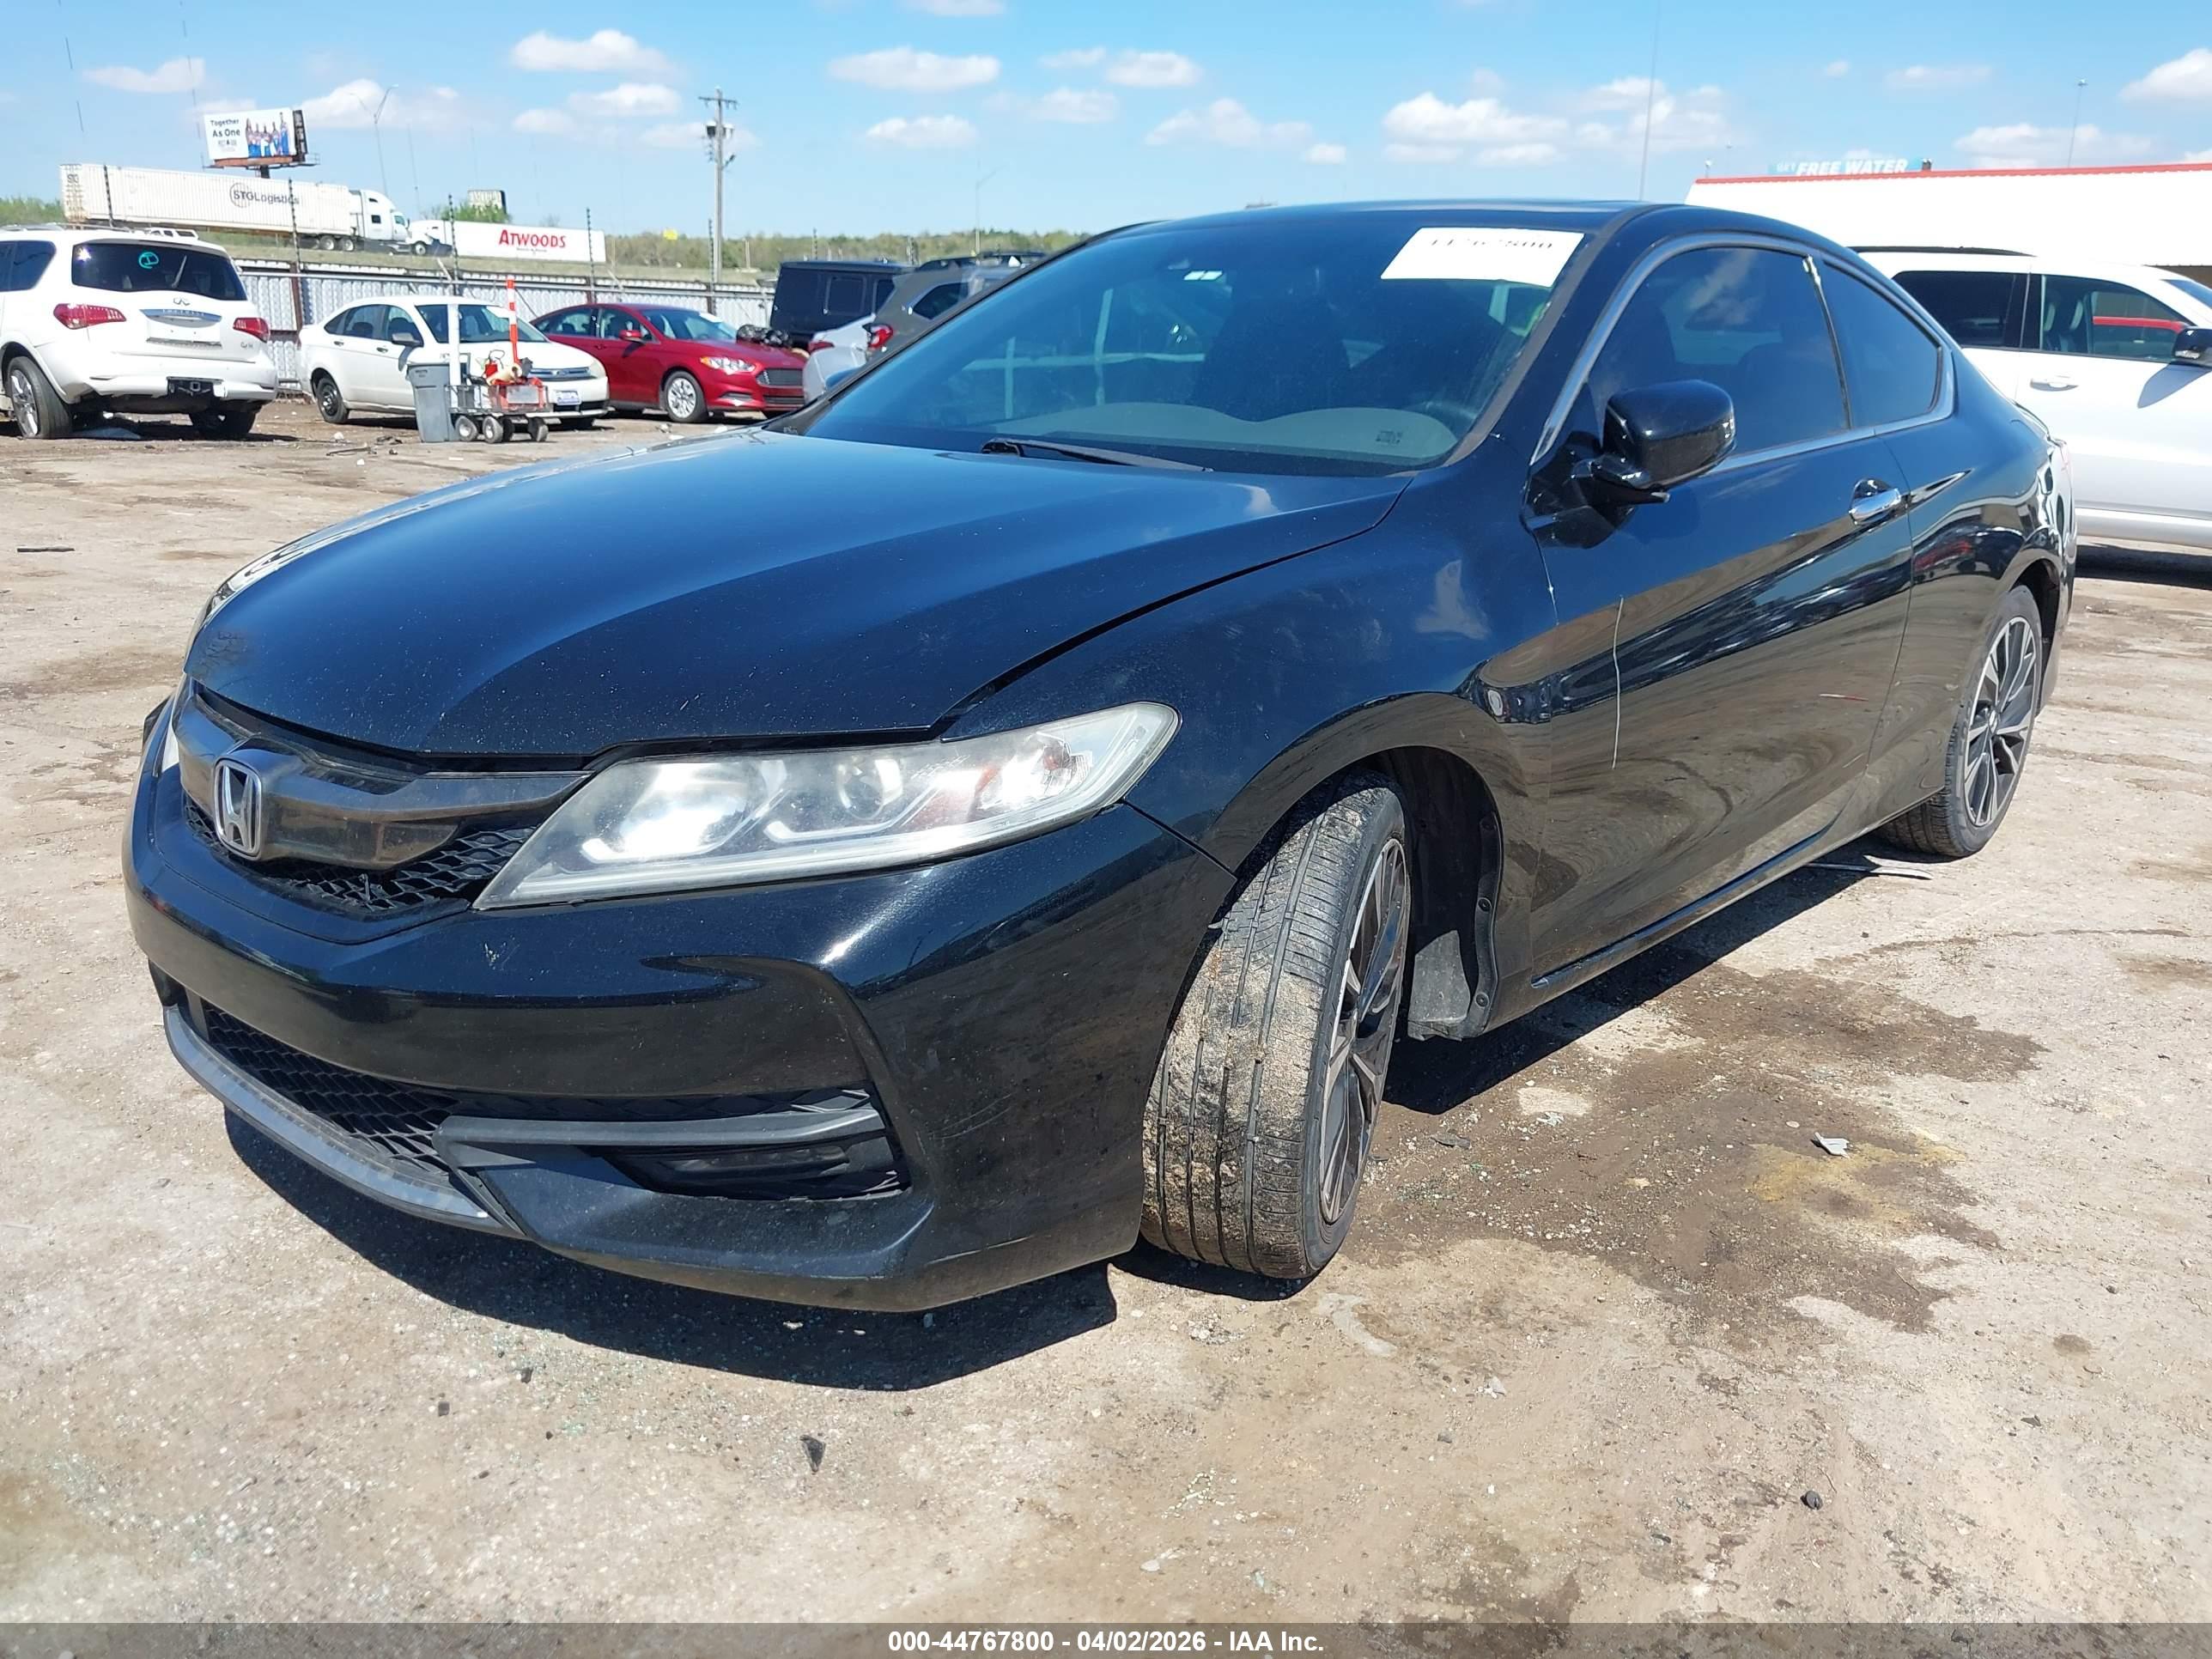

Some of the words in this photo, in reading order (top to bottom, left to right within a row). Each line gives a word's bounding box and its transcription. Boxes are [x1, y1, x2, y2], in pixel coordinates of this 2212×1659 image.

[210, 118, 240, 127] Together
[224, 128, 240, 137] One
[1796, 161, 1842, 175] FREE
[1845, 158, 1908, 174] WATER
